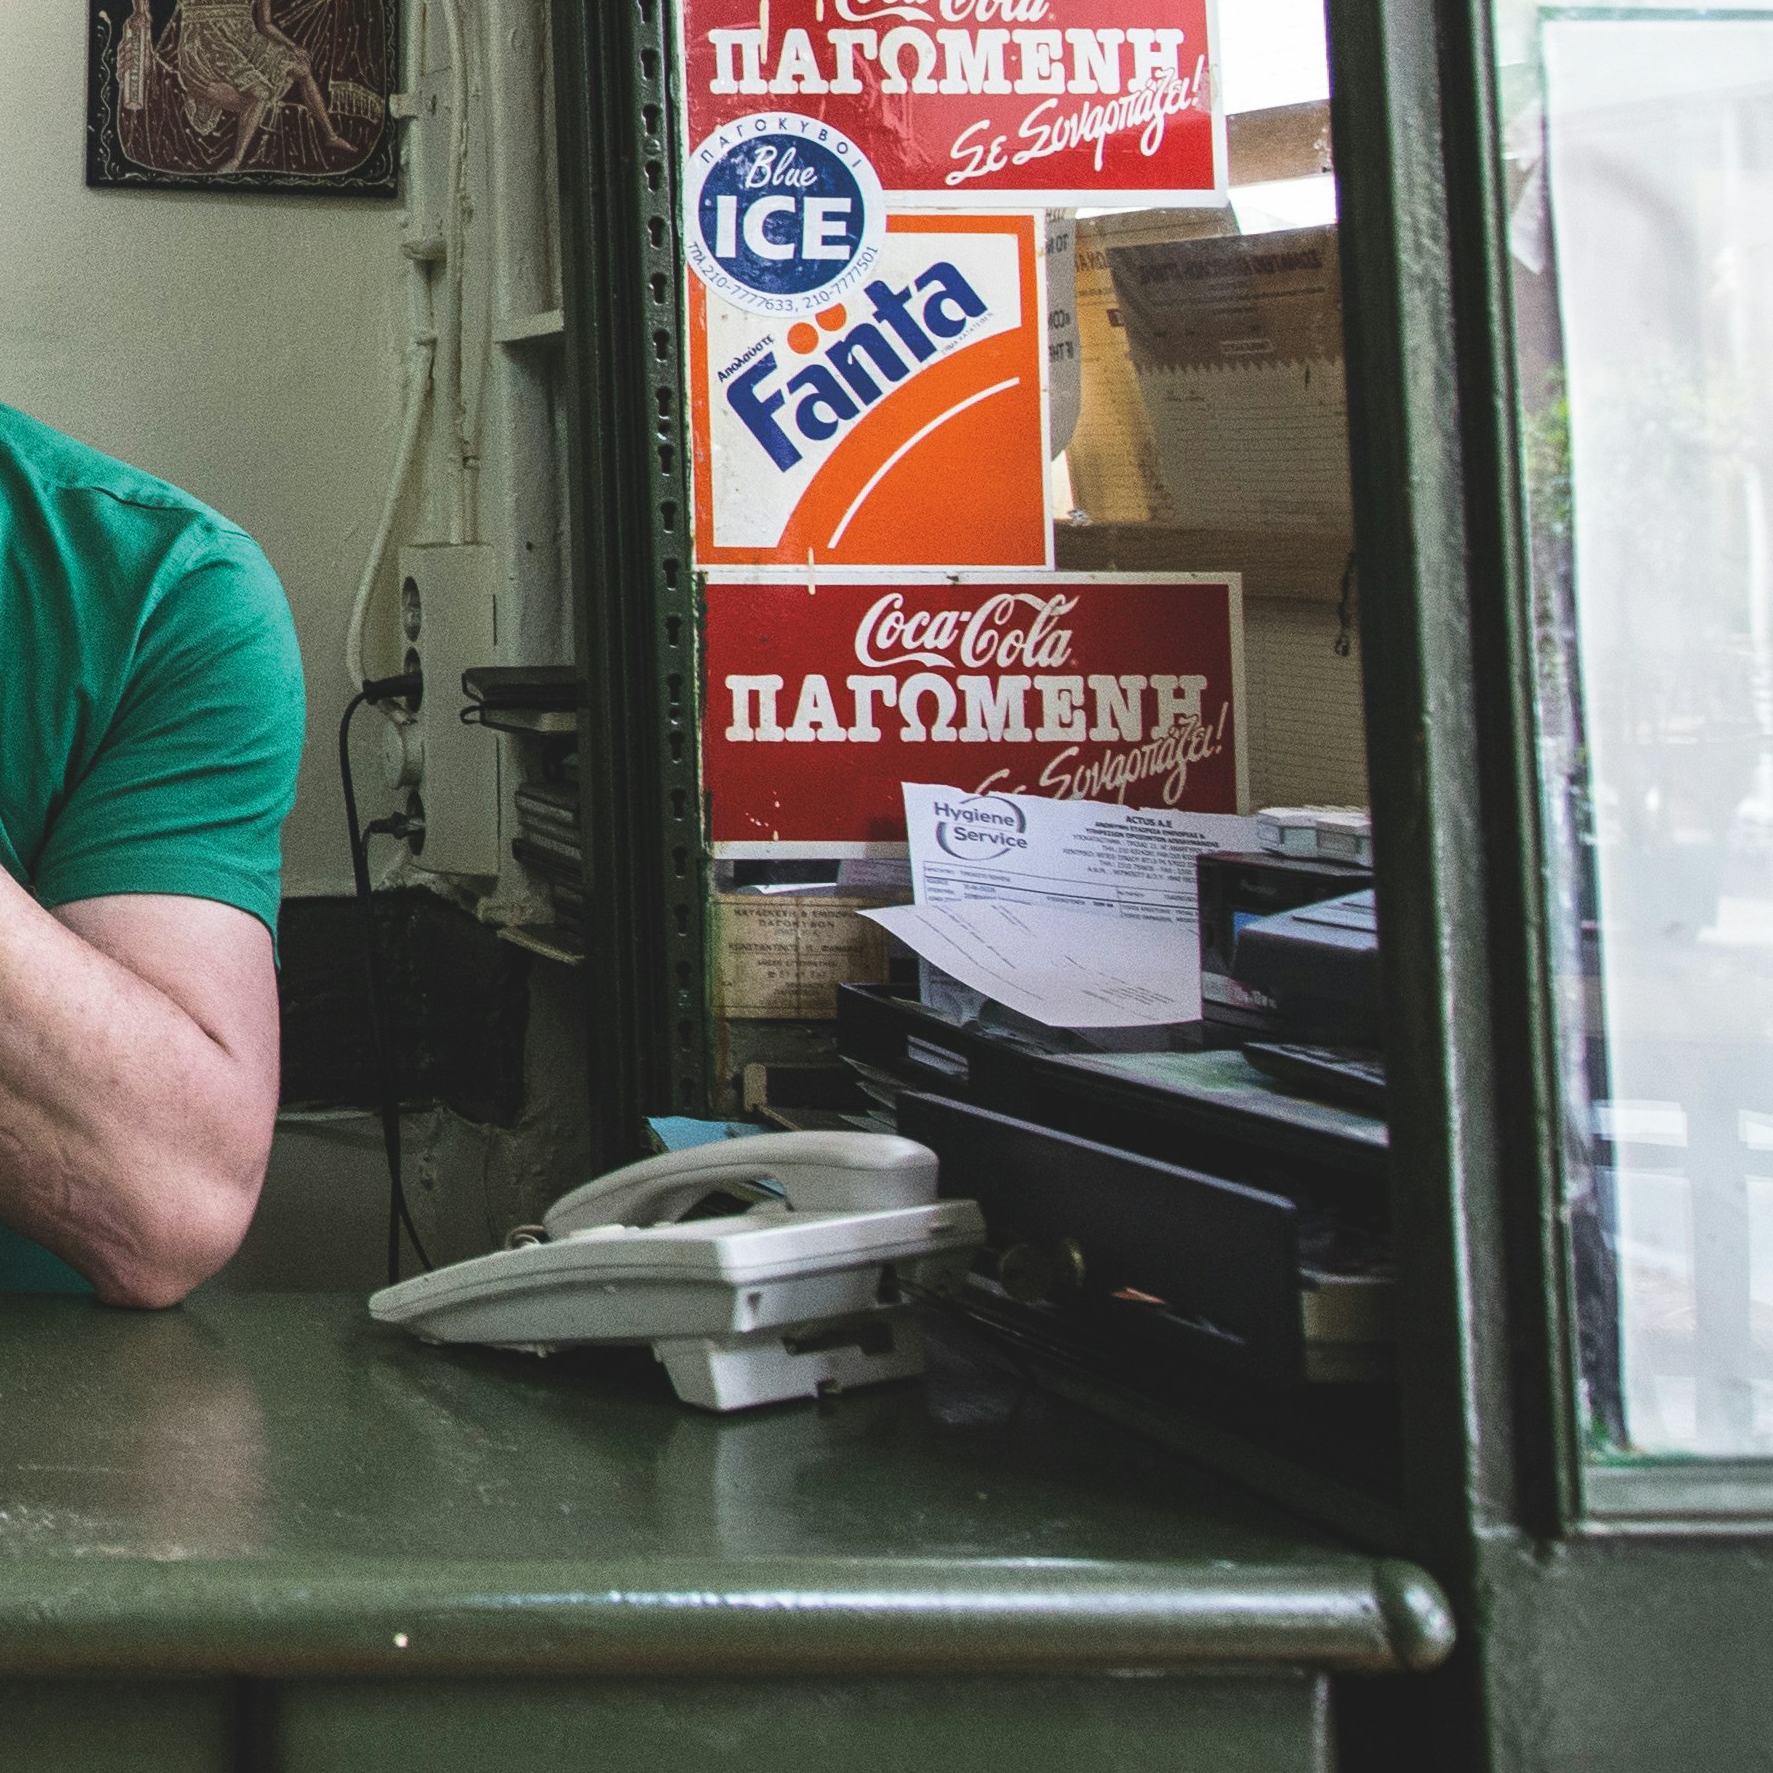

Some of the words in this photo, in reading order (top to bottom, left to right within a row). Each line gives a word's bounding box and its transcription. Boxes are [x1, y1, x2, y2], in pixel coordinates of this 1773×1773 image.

[708, 24, 1185, 95] ΠΑΓΩΜΕΝΗ
[700, 117, 863, 169] ΠΑΓΟΚΥΒΟΙ
[744, 144, 819, 189] Blue
[715, 194, 852, 261] ICE
[726, 261, 989, 473] Fanta
[855, 592, 1081, 668] Coca-Cola
[724, 672, 1208, 743] ΠΑΓΩΜΕΝΗ
[934, 801, 1015, 827] Hygiene
[952, 826, 1028, 850] Service
[1125, 815, 1156, 827] ACTUS
